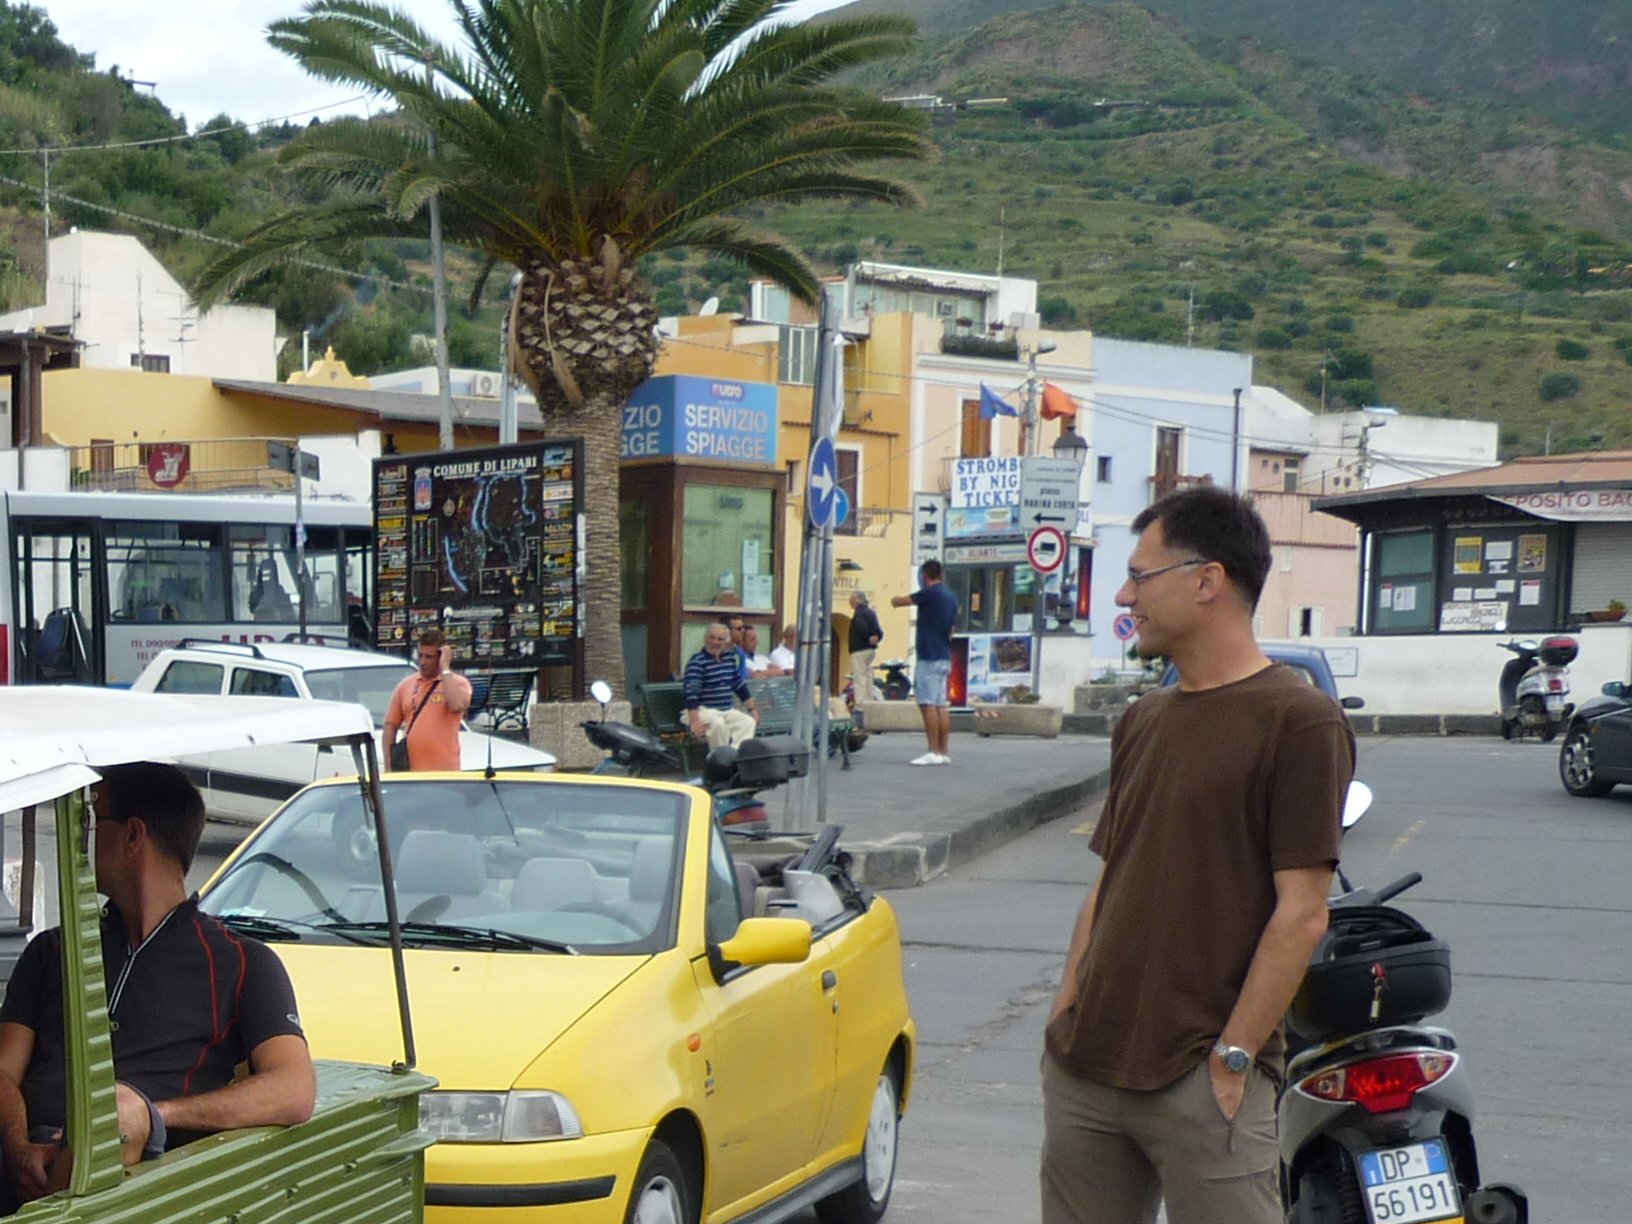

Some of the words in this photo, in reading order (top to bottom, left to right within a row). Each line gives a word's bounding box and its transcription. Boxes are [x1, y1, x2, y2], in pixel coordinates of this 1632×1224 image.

[685, 403, 768, 433] SERVIZIO
[686, 430, 766, 460] SPIAGGE
[433, 462, 481, 477] COMUNE
[484, 460, 497, 472] DI
[500, 456, 538, 469] LIPARI
[956, 457, 1021, 475] STROMB
[960, 476, 978, 492] BY
[990, 473, 1018, 489] NIG
[964, 490, 1020, 507] TICKE
[1502, 493, 1591, 509] EPOSITO
[1379, 1150, 1410, 1180] DP
[1374, 1180, 1449, 1220] 56191
